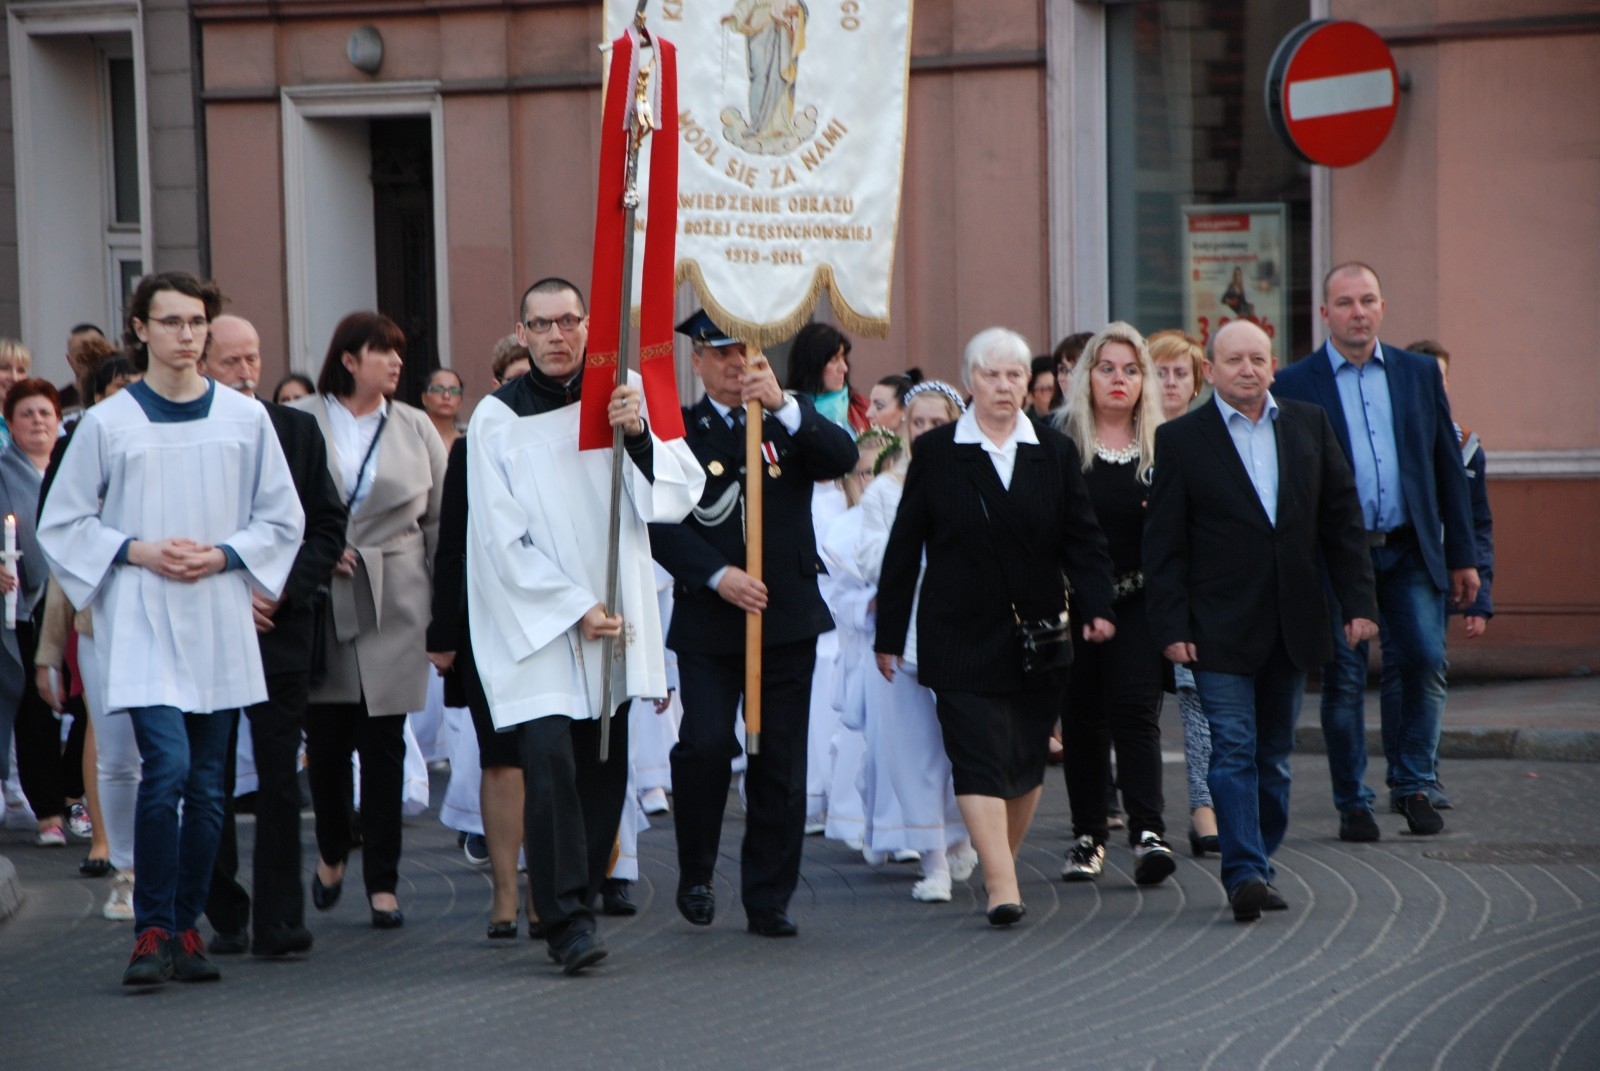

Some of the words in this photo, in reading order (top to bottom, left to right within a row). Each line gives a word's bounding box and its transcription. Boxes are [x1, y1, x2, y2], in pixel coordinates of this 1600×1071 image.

[770, 164, 798, 190] ZA
[800, 117, 848, 172] NAMI
[678, 193, 780, 213] WIEDZENIE
[788, 196, 854, 213] OBRAZU
[684, 218, 731, 236] BOŻEJ
